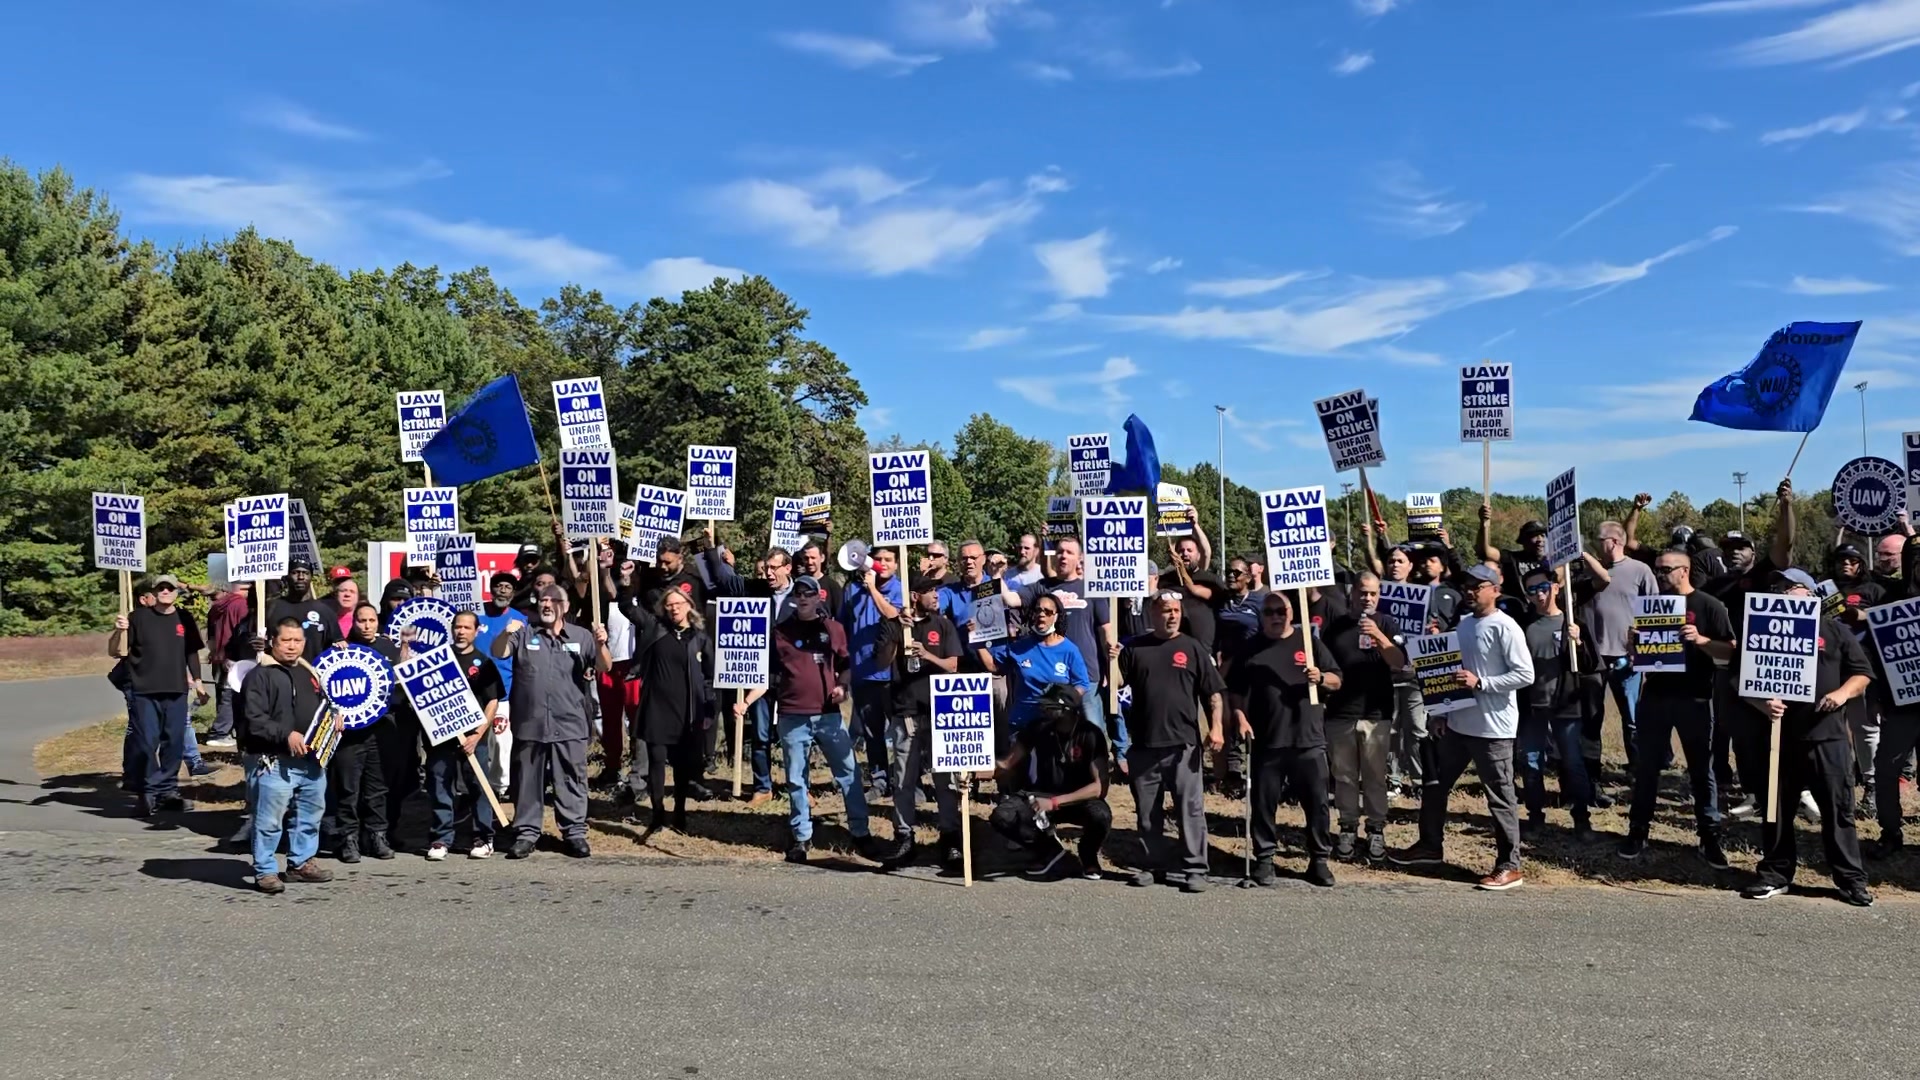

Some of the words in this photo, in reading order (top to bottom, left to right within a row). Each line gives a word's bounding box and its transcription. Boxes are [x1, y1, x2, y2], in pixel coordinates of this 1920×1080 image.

[1462, 366, 1509, 378] UAW
[556, 380, 598, 396] UAW
[1476, 381, 1494, 393] ON
[400, 394, 440, 405] UAW
[572, 397, 590, 410] ON
[1317, 392, 1362, 414] UAW
[1464, 394, 1508, 406] STRIKE
[414, 407, 430, 418] ON
[561, 409, 603, 424] STRIKE
[1336, 410, 1355, 424] ON
[1469, 409, 1503, 418] UNFAIR
[403, 418, 442, 430] STRIKE
[1328, 419, 1372, 439] STRIKE
[1470, 419, 1501, 427] LABOR
[569, 425, 600, 436] UNFAIR
[1464, 428, 1509, 438] PRACTICE
[572, 434, 601, 446] LABOR
[1070, 436, 1107, 447] UAW
[1336, 434, 1371, 449] UNFAIR
[691, 449, 733, 460] UAW
[1082, 449, 1097, 459] ON
[1341, 444, 1372, 458] LABOR
[562, 452, 610, 464] UAW
[872, 454, 924, 470] UAW
[1336, 450, 1382, 468] PRACTICE
[703, 463, 720, 474] ON
[1073, 459, 1109, 470] STRIKE
[578, 470, 596, 482] ON
[691, 475, 731, 486] STRIKE
[889, 474, 909, 487] ON
[1078, 472, 1105, 480] UNFAIR
[1080, 480, 1104, 488] LABOR
[1547, 471, 1574, 497] UAW
[408, 491, 453, 502] UAW
[566, 484, 611, 497] STRIKE
[641, 488, 684, 504] UAW
[695, 489, 726, 498] UNFAIR
[875, 488, 926, 504] STRIKE
[1074, 488, 1104, 496] PRACTI
[96, 496, 139, 510] UAW
[697, 498, 724, 507] LABOR
[808, 496, 825, 506] UAW
[1265, 490, 1321, 509] UAW
[1412, 496, 1434, 506] UAW
[1555, 494, 1565, 510] ON
[1853, 489, 1886, 506] UAW
[239, 498, 284, 512] UAW
[572, 501, 606, 511] UNFAIR
[650, 505, 668, 517] ON
[1052, 500, 1070, 511] UAW
[1086, 501, 1143, 515] UAW
[422, 506, 440, 517] ON
[574, 512, 606, 522] LABOR
[623, 507, 634, 519] UA
[690, 507, 730, 516] PRACTICE
[785, 512, 798, 521] ON
[882, 506, 920, 518] UNFAIR
[1549, 504, 1574, 528] STRIKE
[108, 512, 126, 524] ON
[251, 514, 269, 527] ON
[410, 518, 455, 530] STRIKE
[637, 515, 678, 531] STRIKE
[884, 518, 919, 529] LABOR
[1285, 512, 1308, 527] ON
[98, 523, 140, 537] STRIKE
[567, 523, 614, 533] PRACTICE
[775, 520, 801, 530] STRIK
[1104, 520, 1126, 535] ON
[240, 526, 283, 541] STRIKE
[877, 529, 928, 542] PRACTICE
[1270, 526, 1325, 544] STRIKE
[103, 538, 135, 548] UNFAIR
[244, 543, 277, 554] UNFAIR
[417, 543, 435, 551] LAB
[640, 539, 656, 548] LAB
[1088, 537, 1143, 551] STRIKE
[105, 548, 134, 557] LABOR
[245, 553, 276, 564] LABOR
[411, 553, 436, 562] PRAC
[631, 547, 655, 558] PRAC
[1279, 546, 1321, 560] UNFAIR
[99, 556, 141, 567] PRACTICE
[445, 553, 461, 566] ON
[1095, 556, 1137, 567] UNFAIR
[1282, 558, 1320, 572] LABOR
[238, 562, 283, 575] PRACTICE
[1097, 569, 1135, 579] LABOR
[1275, 569, 1330, 585] PRACTICE
[440, 583, 472, 592] UNFAIR
[1088, 581, 1144, 592] PRACTICE
[456, 602, 480, 612] CTICE
[720, 601, 767, 614] UAW
[1391, 604, 1409, 616] ON
[1643, 599, 1675, 614] UAW
[1750, 597, 1817, 615] UAW
[733, 619, 751, 632] ON
[1769, 619, 1794, 635] ON
[1896, 622, 1920, 639] ON
[720, 633, 765, 647] STRIKE
[1639, 631, 1680, 644] FAIR
[1748, 634, 1813, 653] STRIKE
[1418, 636, 1448, 655] UAW
[1636, 644, 1683, 654] WAGES
[1884, 639, 1920, 659] STRI
[724, 651, 759, 661] UNFAIR
[1416, 657, 1444, 666] STAND
[1755, 655, 1804, 669] UNFAIR
[400, 648, 449, 679] UAW
[726, 663, 757, 672] LABOR
[1896, 659, 1920, 674] UNF
[423, 669, 444, 688] ON
[719, 673, 765, 684] PRACTICE
[1757, 667, 1801, 682] LABOR
[331, 677, 367, 697] UAW
[935, 678, 989, 692] UAW
[1423, 683, 1459, 696] SHARIN
[1745, 680, 1811, 696] PRACTICE
[415, 677, 466, 707] STRIKE
[427, 695, 466, 718] UNFAIR
[952, 697, 973, 711] ON
[435, 705, 470, 727] LABOR
[937, 712, 989, 727] STRIKE
[432, 711, 482, 739] PRACTICE
[944, 731, 984, 742] UNFAIR
[946, 743, 982, 754] LABOR
[938, 755, 991, 766] PRACTICE
